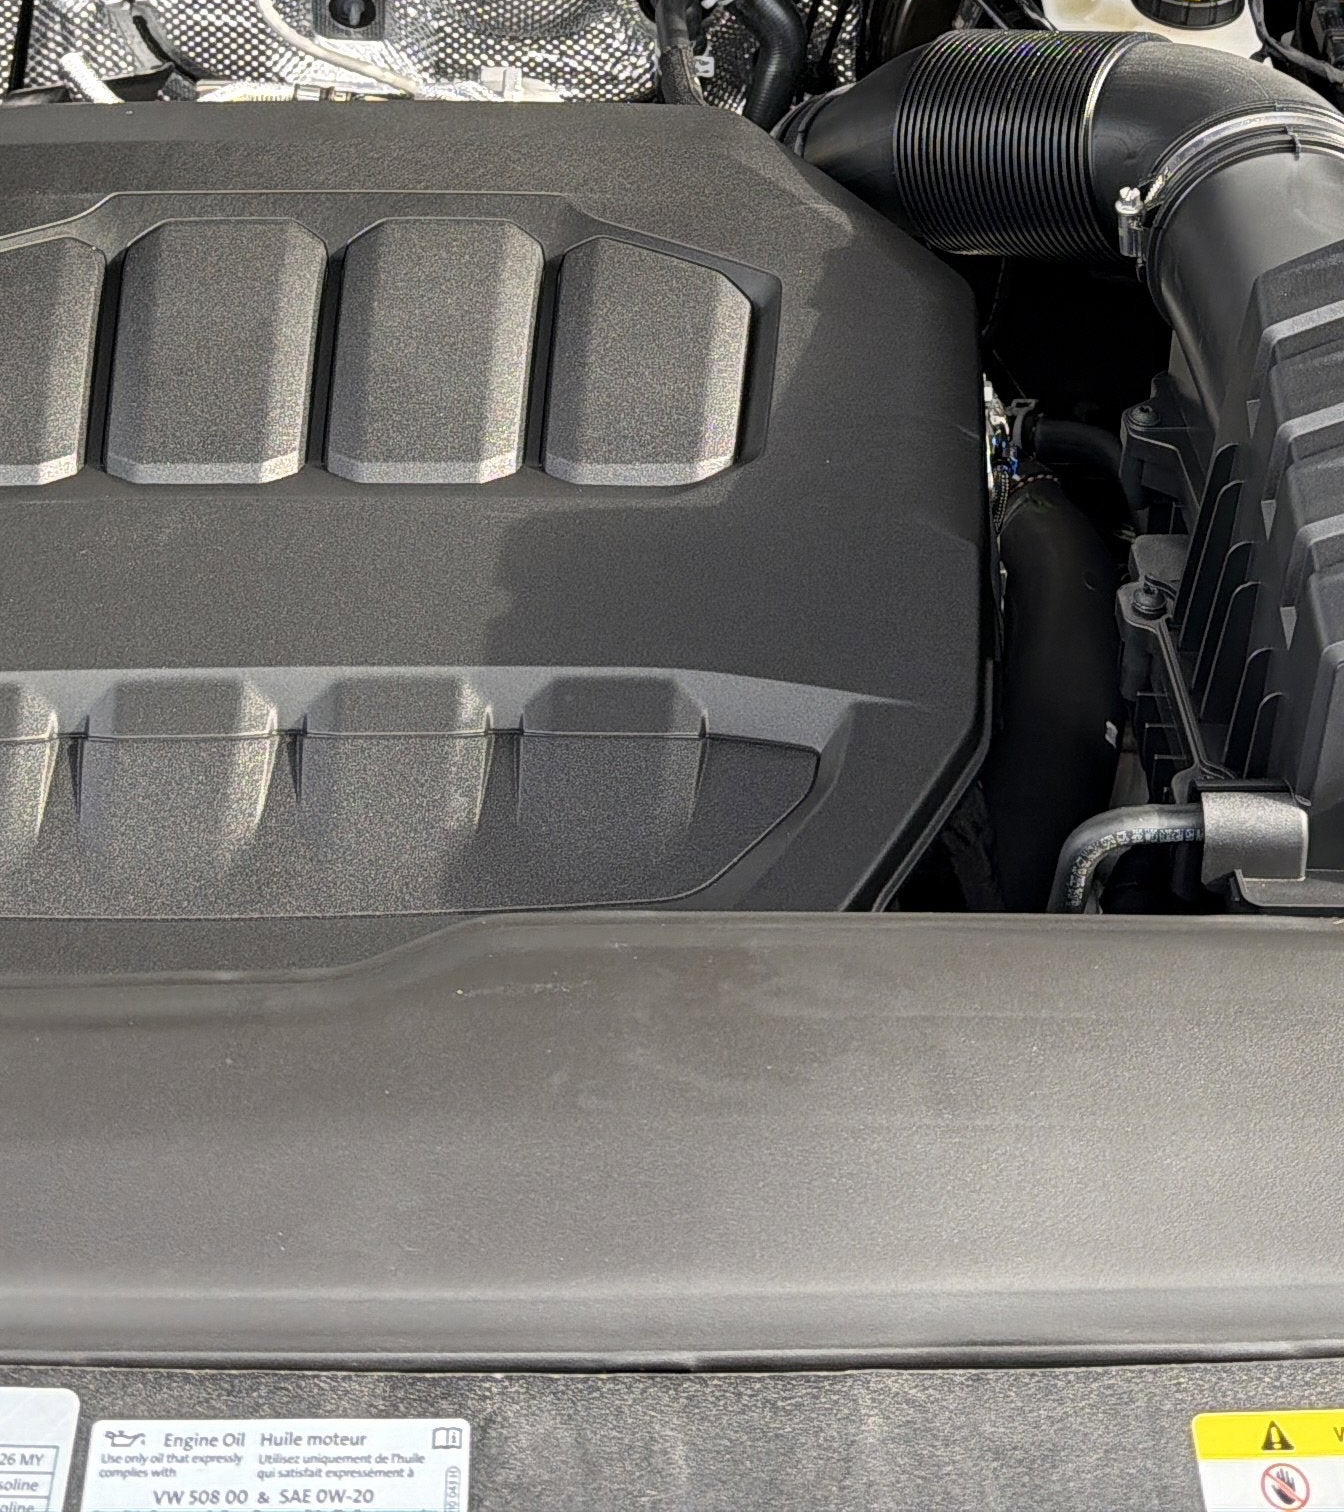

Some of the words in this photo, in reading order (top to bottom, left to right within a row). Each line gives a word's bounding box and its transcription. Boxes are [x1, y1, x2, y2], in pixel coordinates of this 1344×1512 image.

[163, 1432, 219, 1451] Engine
[222, 1432, 246, 1447] Oil
[260, 1432, 303, 1447] Huile
[307, 1433, 367, 1446] moteur
[19, 1453, 44, 1466] MY
[100, 1454, 123, 1464] Use
[124, 1454, 149, 1466] only
[150, 1454, 164, 1464] oil
[166, 1454, 189, 1464] that
[191, 1454, 244, 1466] expressly
[257, 1454, 300, 1465] Utilisez
[302, 1454, 372, 1467] uniquement
[375, 1454, 389, 1464] de
[98, 1468, 149, 1480] complies
[151, 1468, 177, 1478] with
[256, 1468, 276, 1481] qui
[277, 1467, 322, 1479] satisfait
[325, 1467, 404, 1480] expressément
[153, 1490, 185, 1505] VW
[189, 1490, 220, 1505] 508
[225, 1490, 248, 1504] 00
[257, 1491, 269, 1503] &
[279, 1489, 312, 1503] SAE
[316, 1489, 374, 1503] 0W-20
